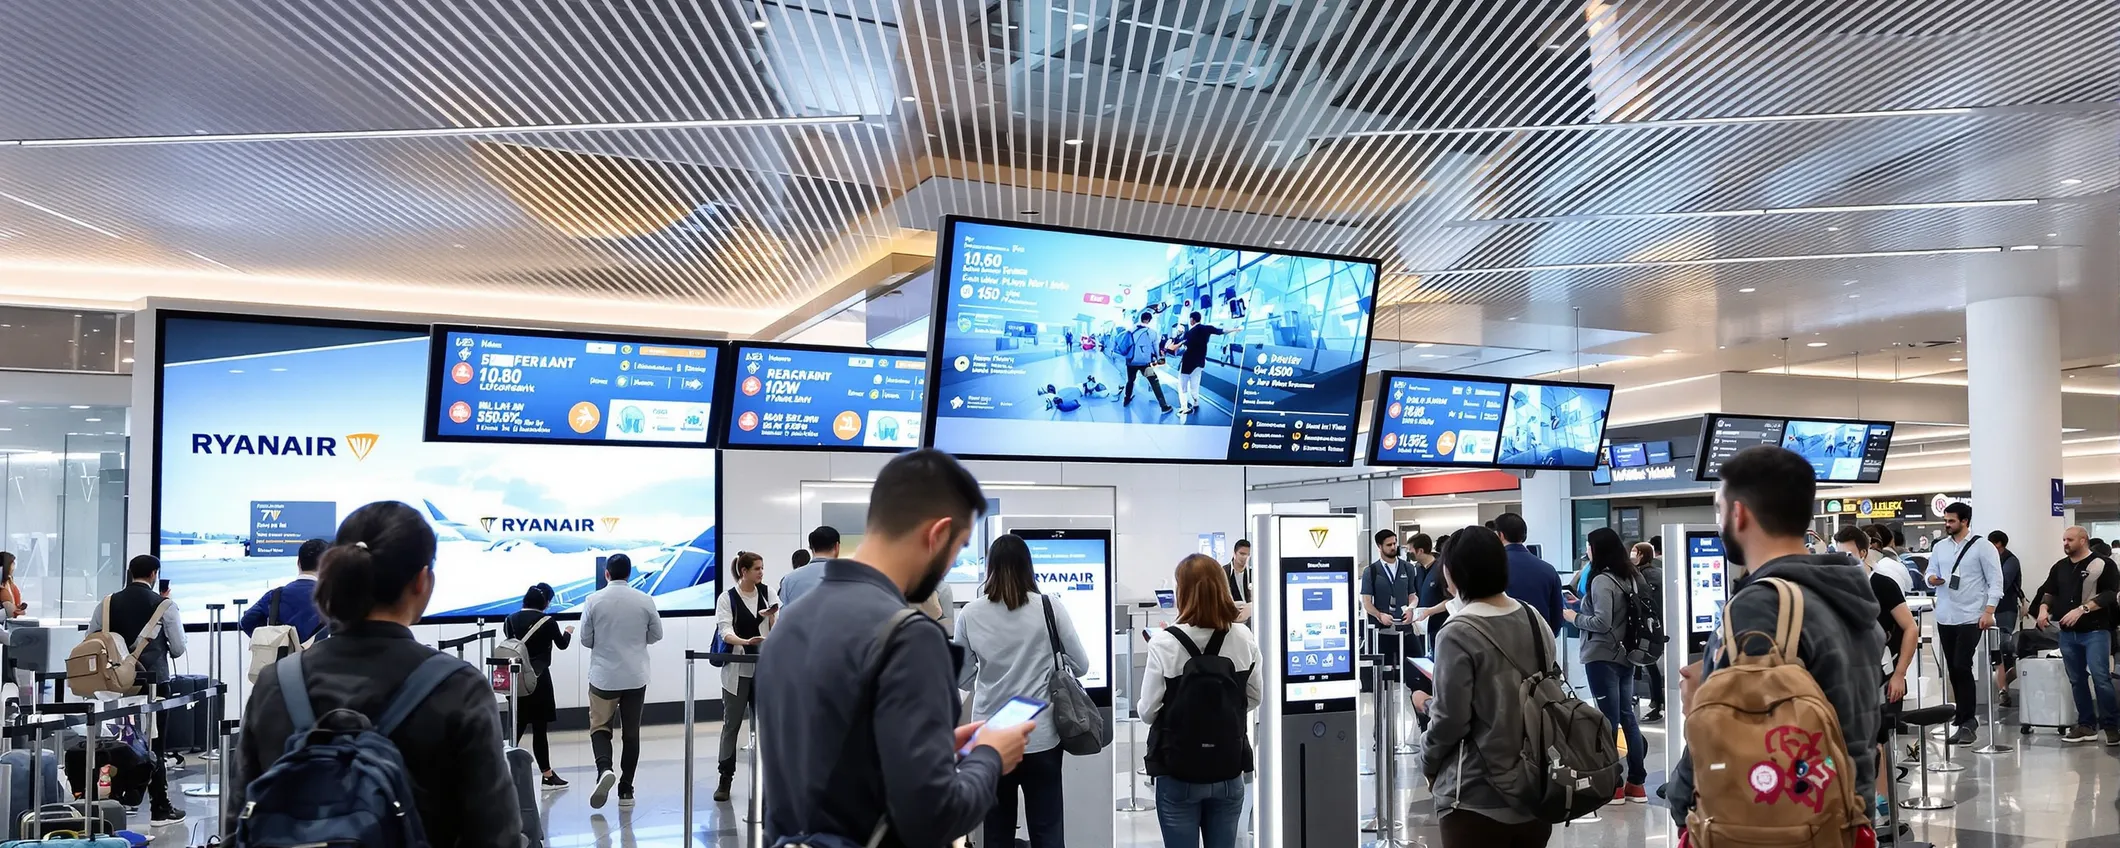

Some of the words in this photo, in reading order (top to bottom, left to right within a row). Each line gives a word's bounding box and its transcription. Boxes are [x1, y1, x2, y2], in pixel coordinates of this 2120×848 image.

[479, 367, 522, 384] 10.80
[192, 433, 337, 457] RYANAIR
[502, 518, 595, 532] RYANAIR
[1034, 572, 1094, 583] RYANAIR
